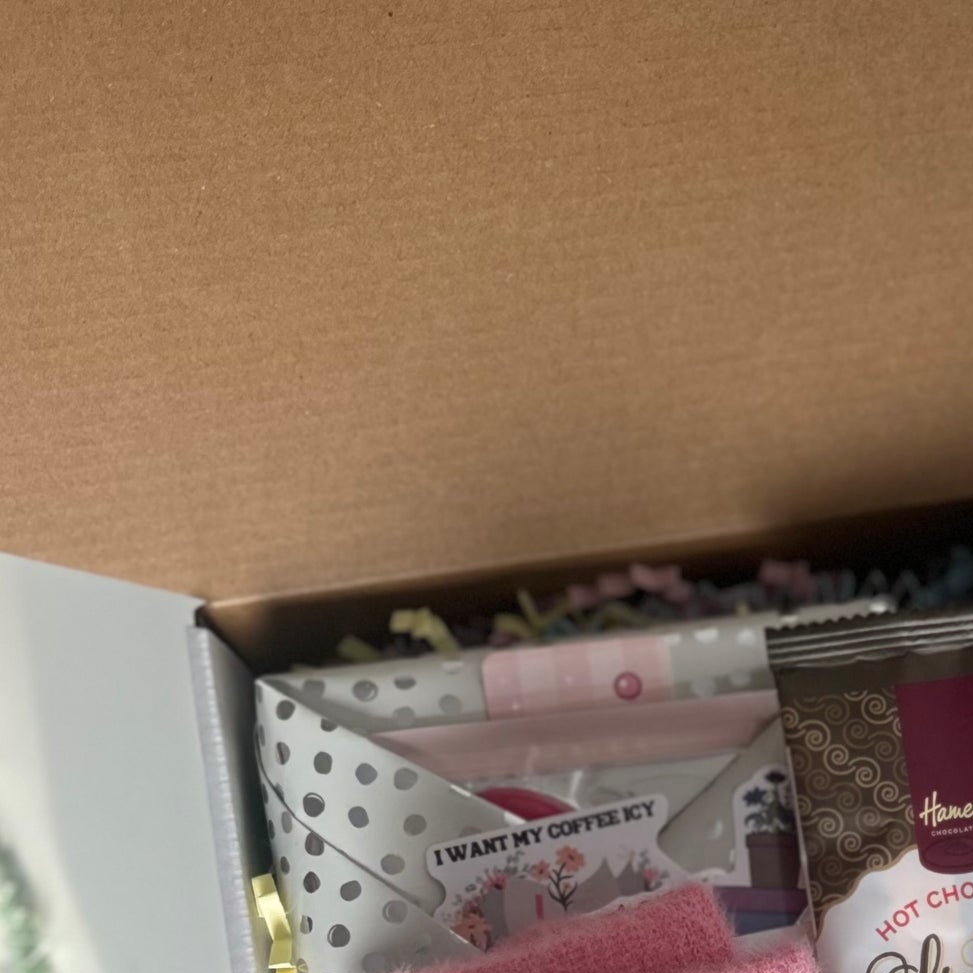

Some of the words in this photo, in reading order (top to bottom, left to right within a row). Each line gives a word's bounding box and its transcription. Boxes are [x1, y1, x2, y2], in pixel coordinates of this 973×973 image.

[434, 850, 444, 867] I
[445, 834, 508, 863] WANT
[512, 827, 542, 848] MY
[547, 809, 620, 839] COFFEE
[623, 800, 656, 823] ICY
[875, 899, 919, 943] HOT
